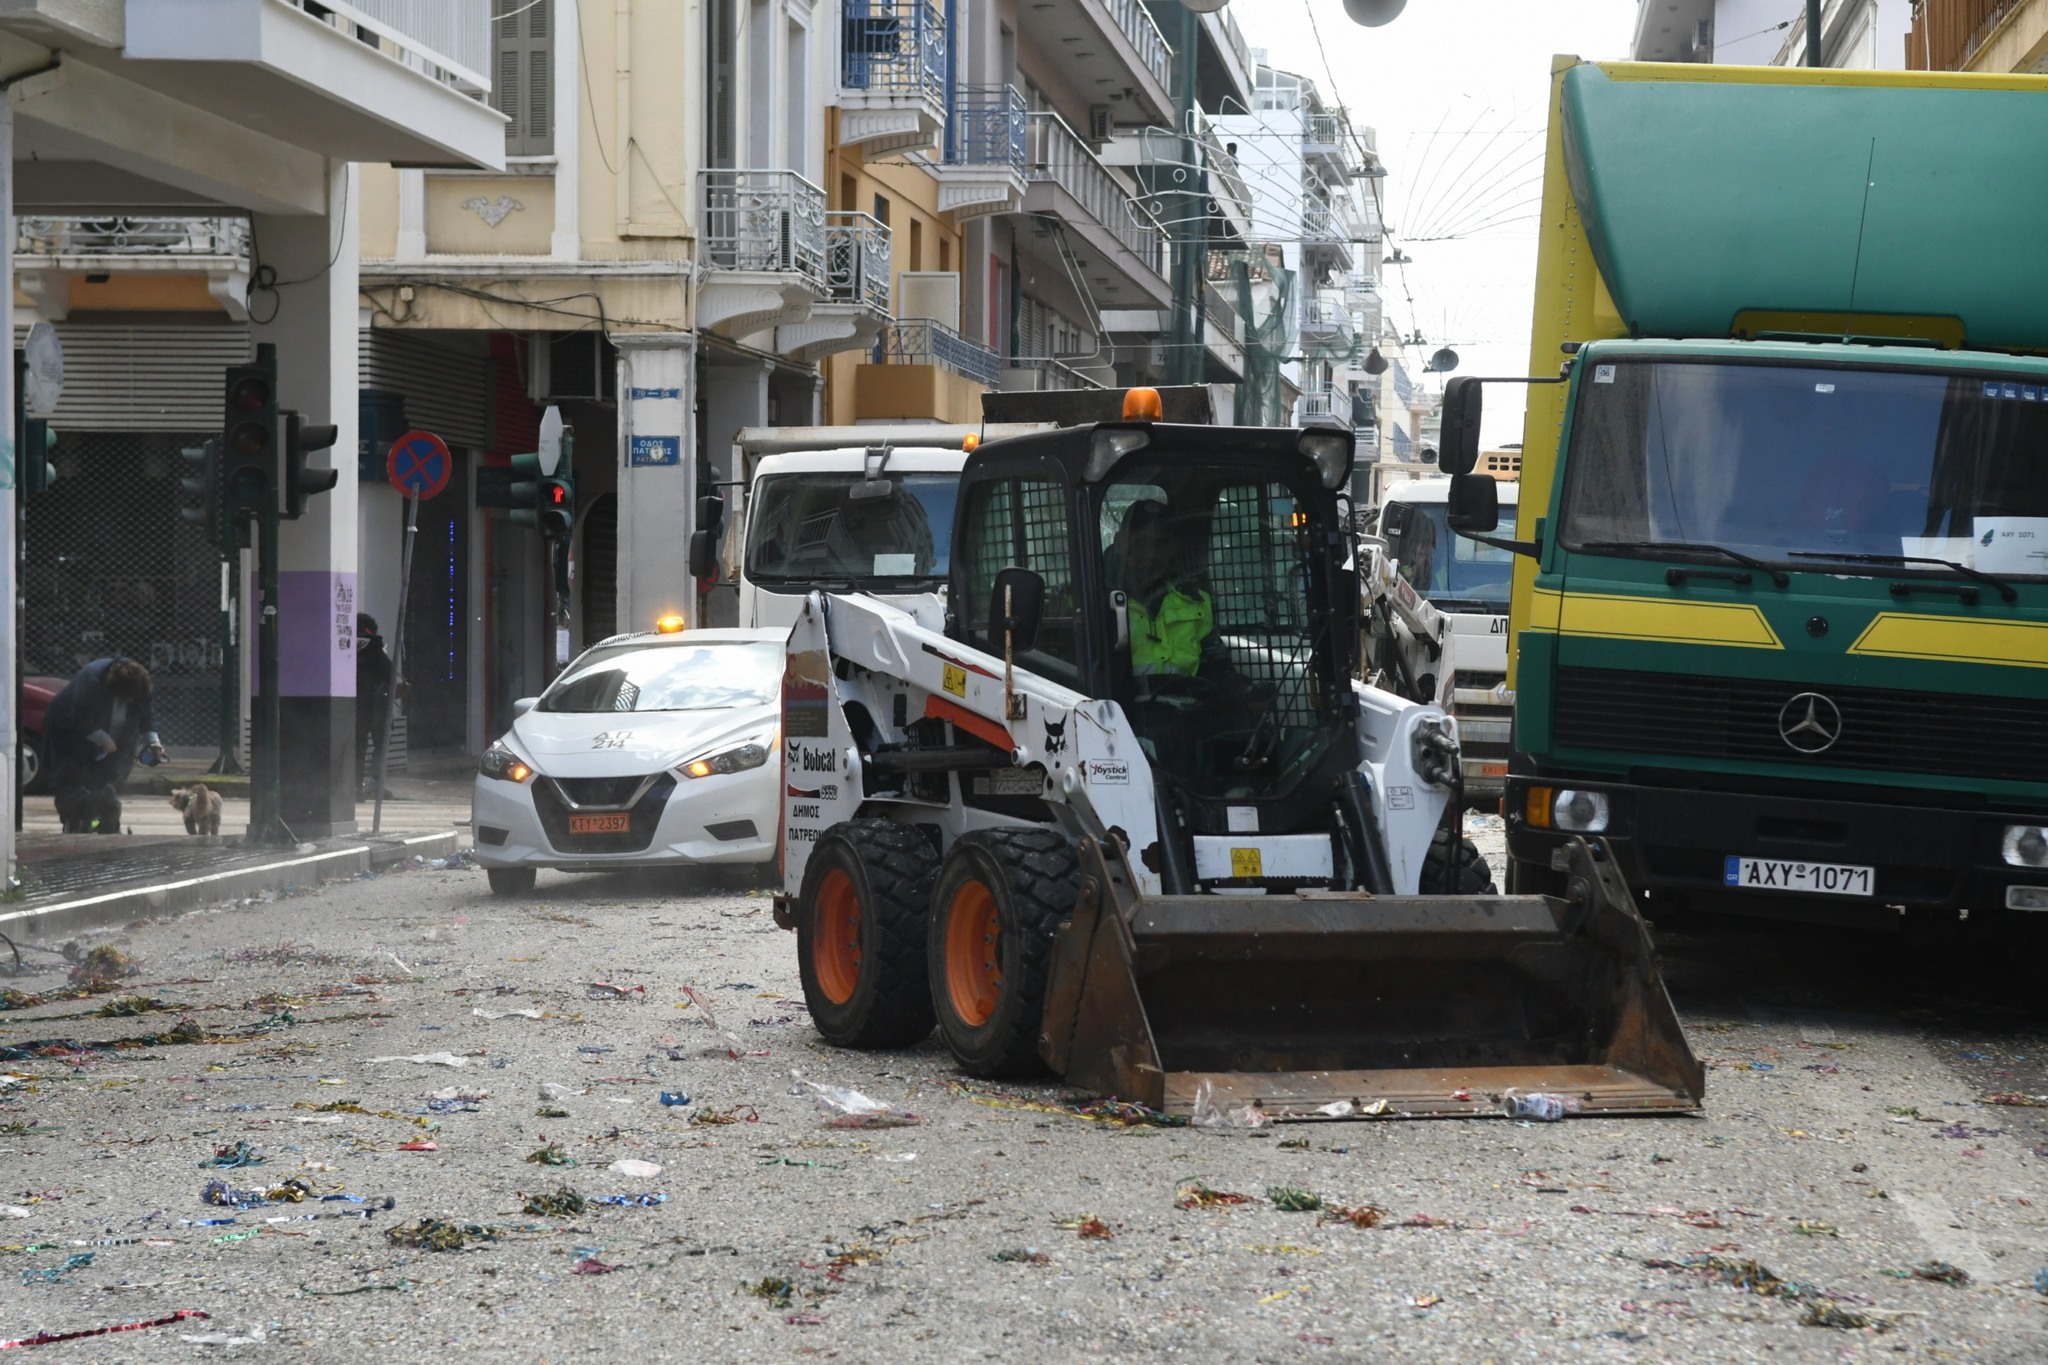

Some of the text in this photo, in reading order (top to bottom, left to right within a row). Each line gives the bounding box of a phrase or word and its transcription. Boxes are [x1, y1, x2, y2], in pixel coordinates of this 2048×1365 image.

[2018, 531, 2035, 539] 1071
[592, 740, 625, 749] 214
[803, 747, 836, 773] Bobcat
[1090, 764, 1127, 776] Joystick
[793, 805, 820, 818] ΔΗΜΟΣ
[1727, 873, 1738, 881] GR
